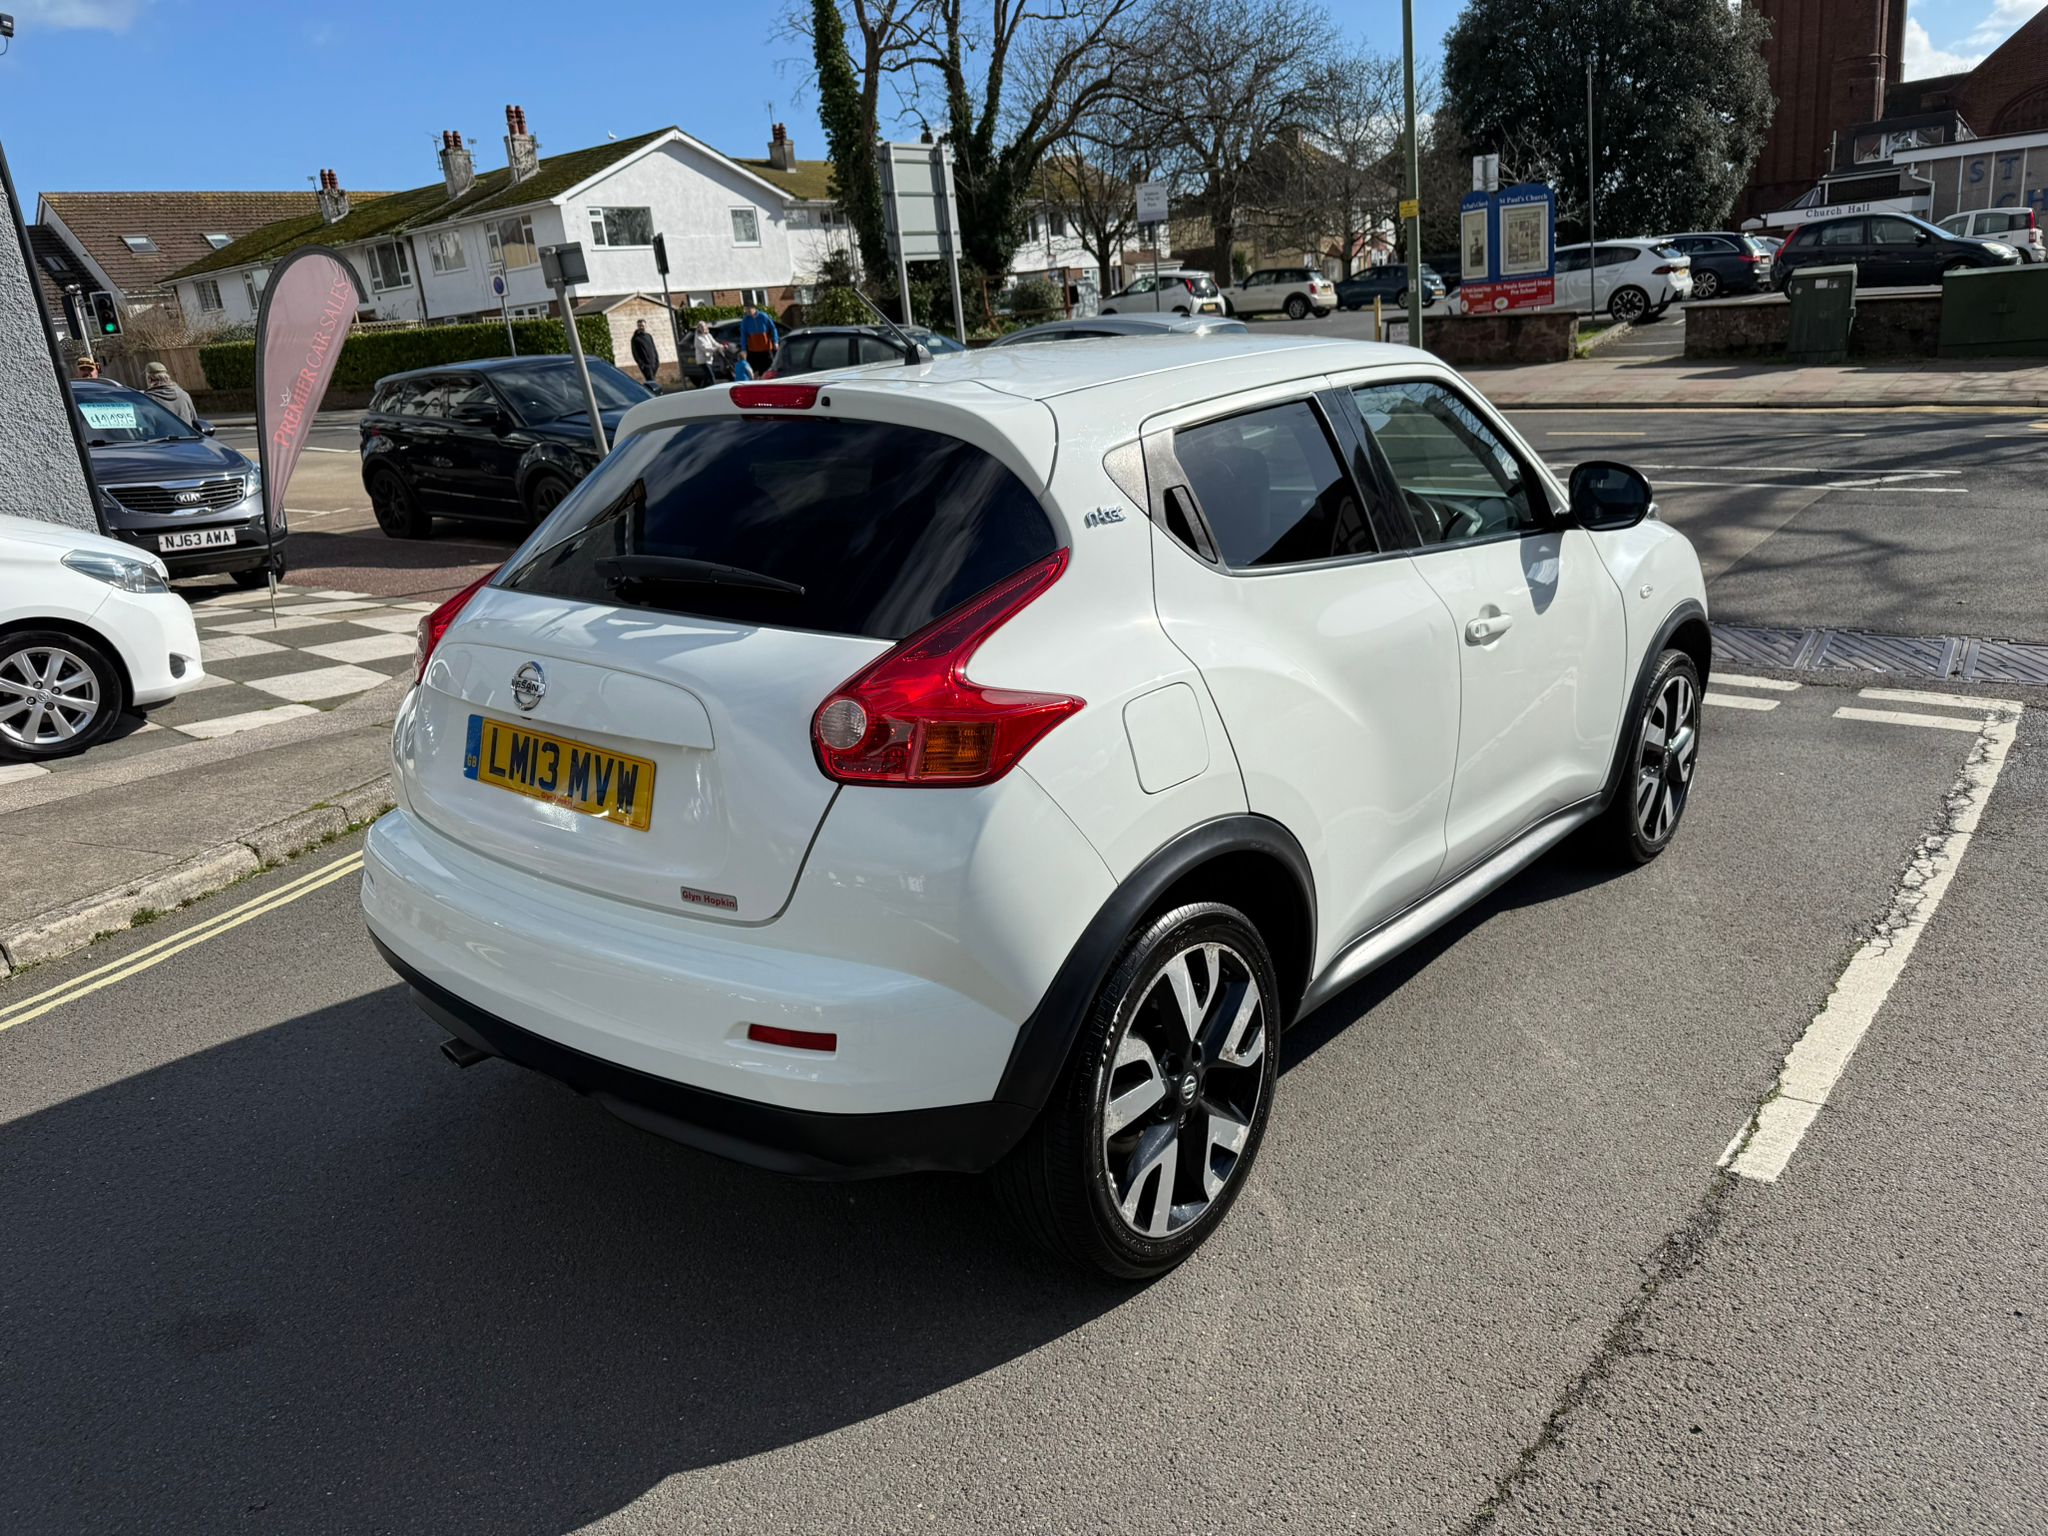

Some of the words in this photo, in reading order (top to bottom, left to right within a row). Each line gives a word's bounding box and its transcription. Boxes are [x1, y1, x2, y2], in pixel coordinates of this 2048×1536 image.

[1506, 194, 1525, 204] Paul's
[1525, 193, 1548, 201] Church
[1805, 206, 1843, 219] Church
[1848, 203, 1871, 214] Hall
[273, 367, 318, 449] PREMIER
[306, 332, 332, 370] CAR
[320, 277, 351, 332] SALES
[179, 493, 199, 503] KIA
[165, 534, 202, 549] NJ63
[205, 530, 231, 545] AWA
[467, 755, 478, 768] GB
[489, 727, 560, 792] LM13
[567, 748, 639, 815] MVW
[682, 890, 701, 902] Glyn
[703, 894, 735, 908] Hopkin
